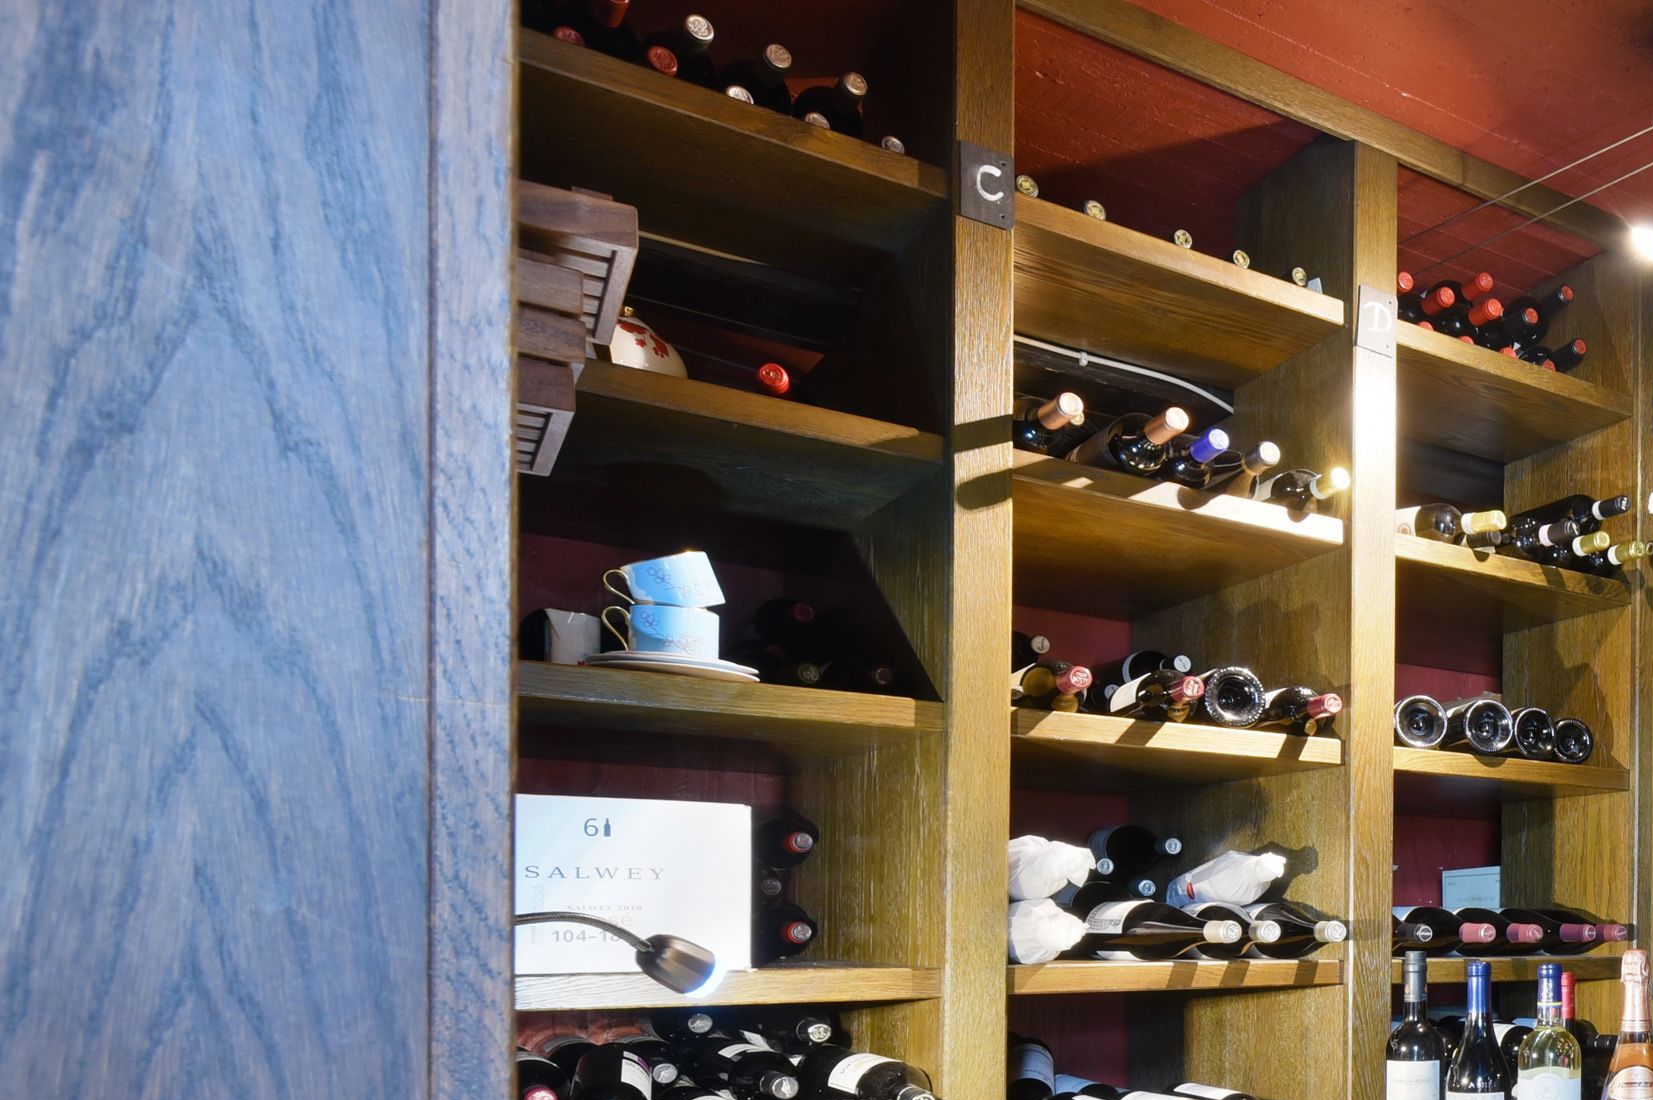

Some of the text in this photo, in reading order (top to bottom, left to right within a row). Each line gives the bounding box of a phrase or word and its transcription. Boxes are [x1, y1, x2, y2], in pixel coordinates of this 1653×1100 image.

[975, 163, 1006, 203] C
[1362, 300, 1393, 333] D
[584, 818, 599, 837] 6
[524, 865, 665, 880] SALWEY
